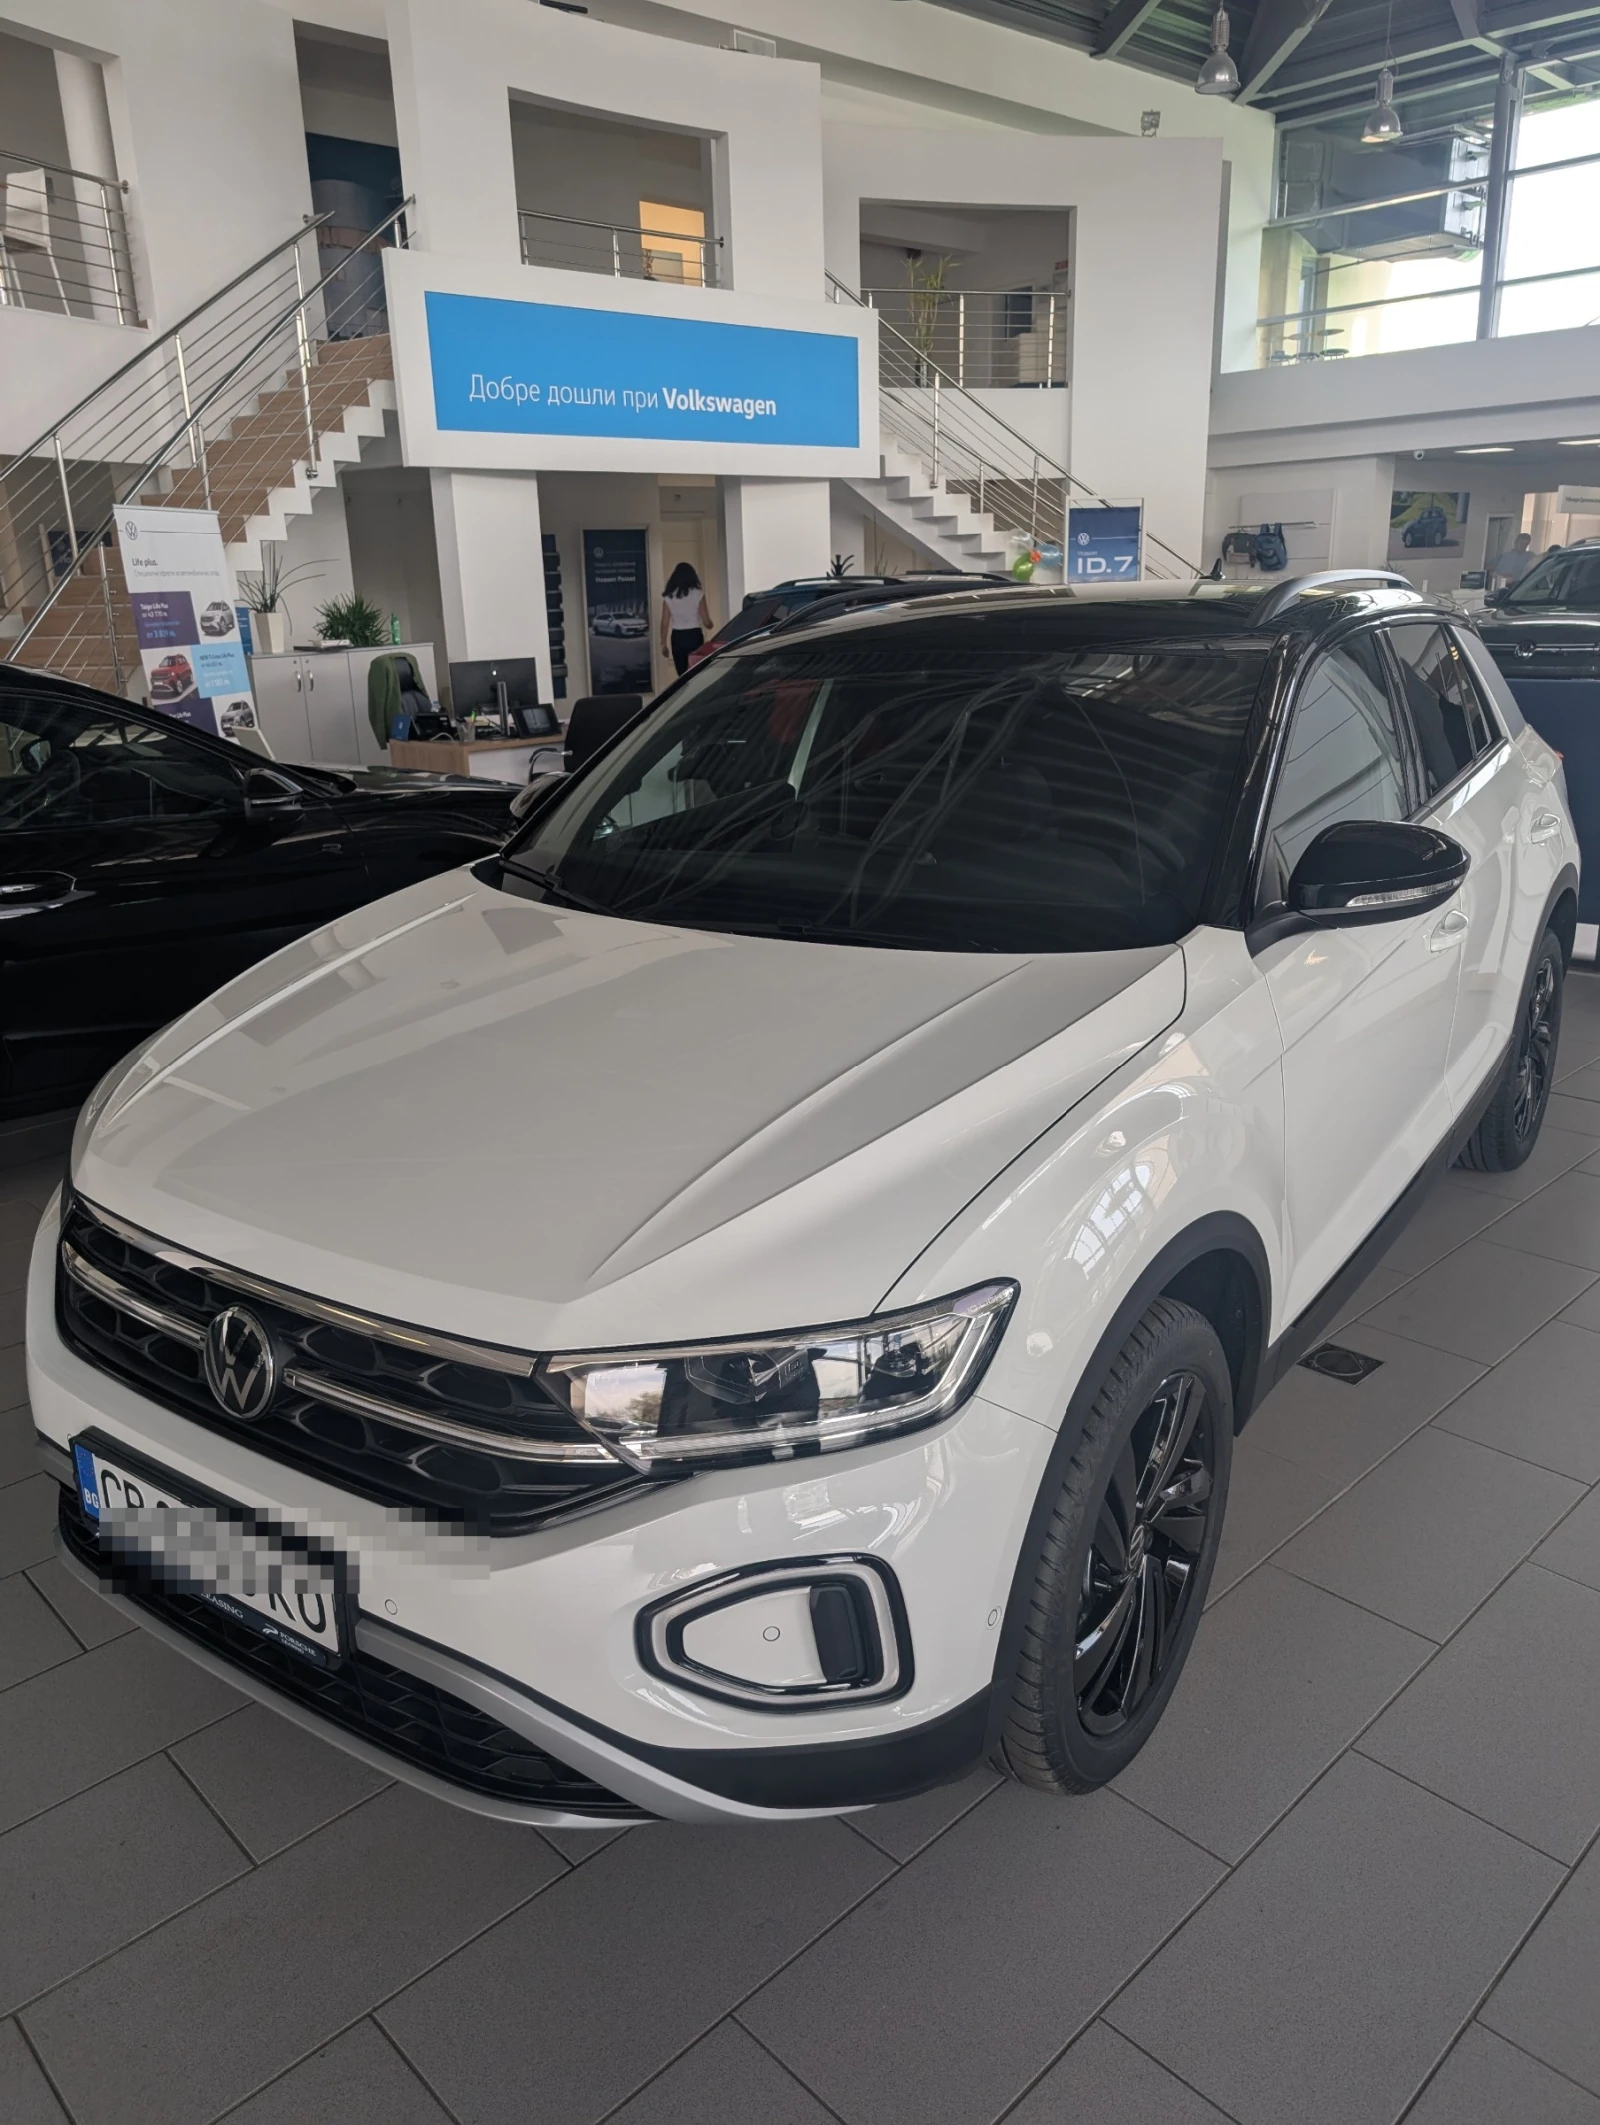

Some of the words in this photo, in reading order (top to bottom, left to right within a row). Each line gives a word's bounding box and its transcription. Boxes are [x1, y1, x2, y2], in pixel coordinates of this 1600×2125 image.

[469, 373, 541, 407] Добре
[547, 385, 616, 407] дошли
[623, 389, 659, 413] при
[662, 387, 777, 420] Volkswagen
[132, 558, 143, 567] Life
[144, 558, 158, 568] plus.
[1077, 555, 1134, 575] ID.7
[84, 1488, 99, 1509] BG
